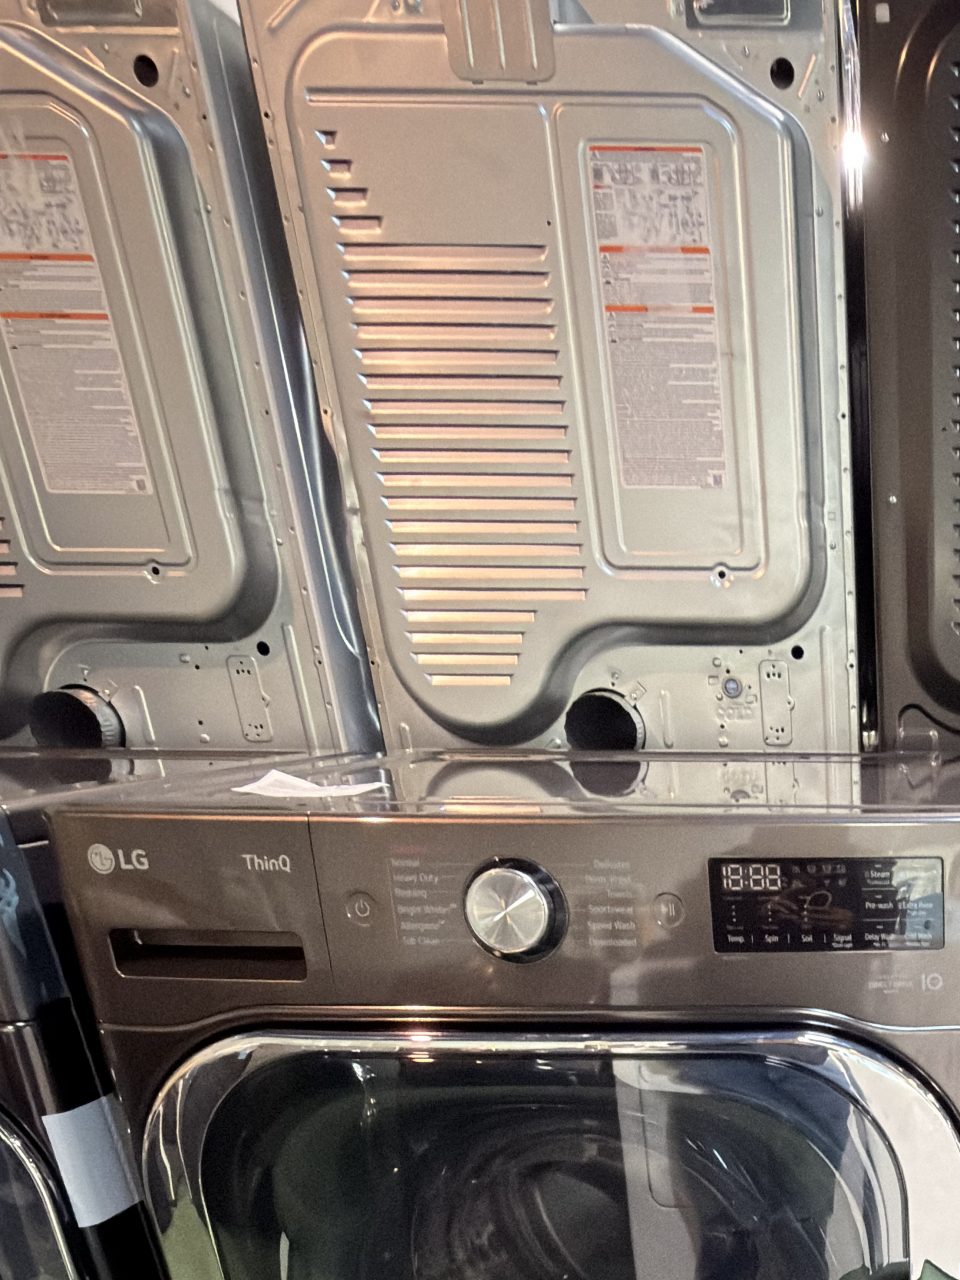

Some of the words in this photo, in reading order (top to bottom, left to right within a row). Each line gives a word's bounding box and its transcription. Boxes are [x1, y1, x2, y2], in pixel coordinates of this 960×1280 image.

[117, 849, 150, 871] LG
[241, 854, 292, 874] ThinQ
[419, 872, 439, 885] Duty
[764, 934, 779, 944] Spin
[801, 934, 813, 943] Soil
